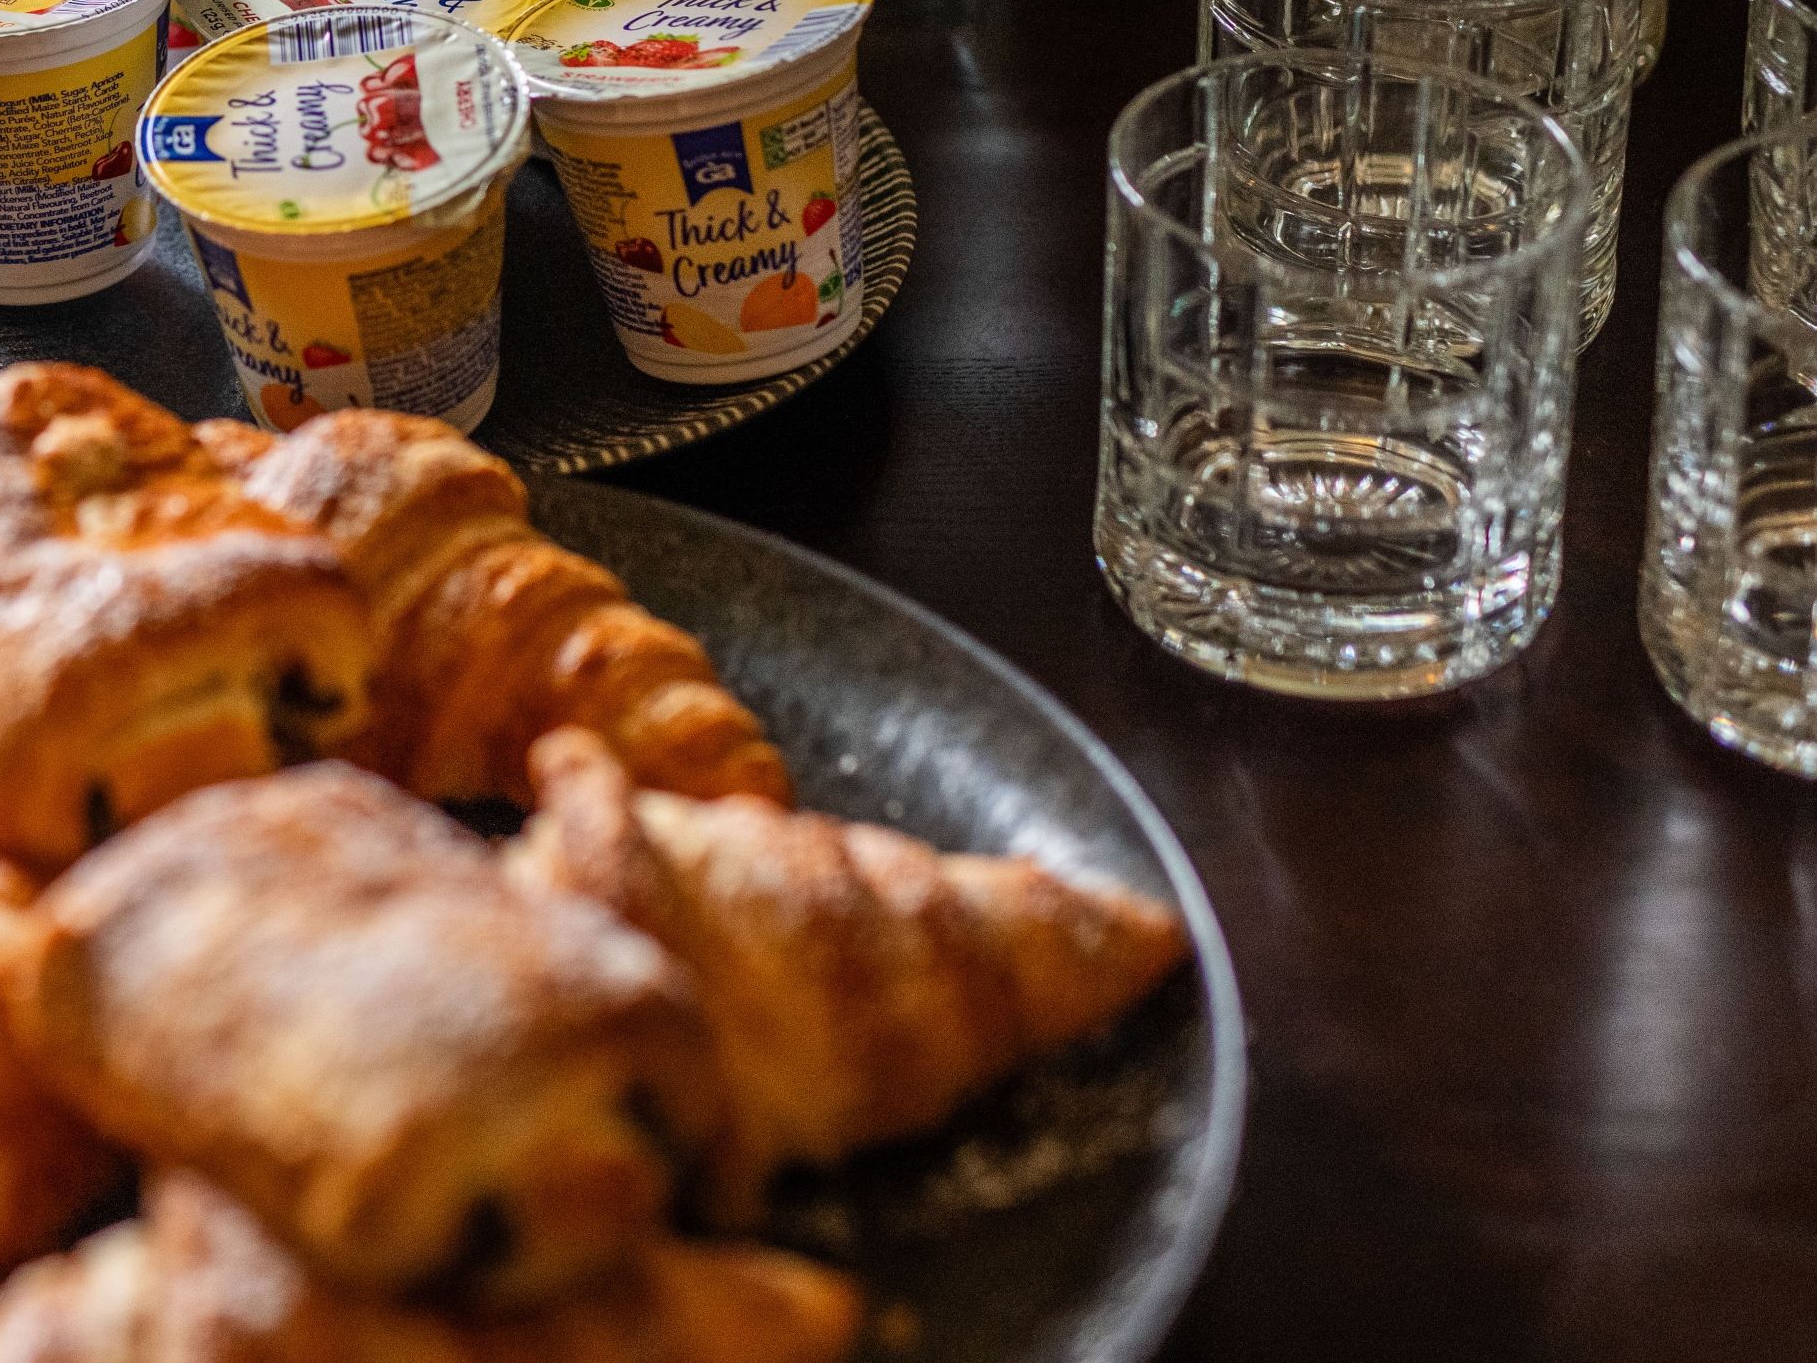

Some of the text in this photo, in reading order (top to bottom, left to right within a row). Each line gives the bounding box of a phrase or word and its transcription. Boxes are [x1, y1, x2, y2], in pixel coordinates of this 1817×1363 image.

[199, 7, 225, 31] 125g
[233, 1, 261, 23] CHE
[622, 10, 768, 41] Creamy
[29, 92, 57, 106] (Milk),
[61, 86, 89, 99] Sugar,
[90, 71, 125, 90] Apricots
[31, 102, 60, 113] Maize
[62, 93, 93, 108] Starch,
[94, 82, 120, 98] Carob
[40, 109, 76, 121] Natural
[77, 91, 122, 112] Flavouring,
[14, 132, 43, 142] Sugar,
[45, 124, 84, 138] Cherries
[33, 119, 64, 131] Colour
[228, 89, 283, 179] Thick &
[290, 79, 354, 169] Creamy
[11, 141, 40, 151] Maize
[41, 135, 72, 148] Starch,
[74, 125, 104, 140] Pectin),
[53, 138, 93, 154] Beetroot
[93, 129, 114, 144] Juice
[8, 167, 40, 178] Acidity
[41, 158, 88, 175] Regulators
[11, 159, 35, 169] Juice
[36, 148, 93, 166] Concentrate,
[12, 175, 53, 187] Citrates).
[14, 185, 43, 195] (Milk),
[44, 181, 71, 192] Sugar,
[34, 189, 76, 202] (Modified
[77, 181, 101, 193] Maize
[31, 197, 79, 211] Flavouring,
[79, 184, 113, 201] Beetroot
[0, 221, 39, 231] DIETARY
[40, 205, 104, 229] INFORMATION
[17, 207, 70, 221] Concentrate
[70, 202, 90, 212] from
[653, 188, 791, 251] Thick &
[672, 239, 798, 299] Creamy
[215, 303, 265, 345] ick
[230, 339, 306, 406] reamy
